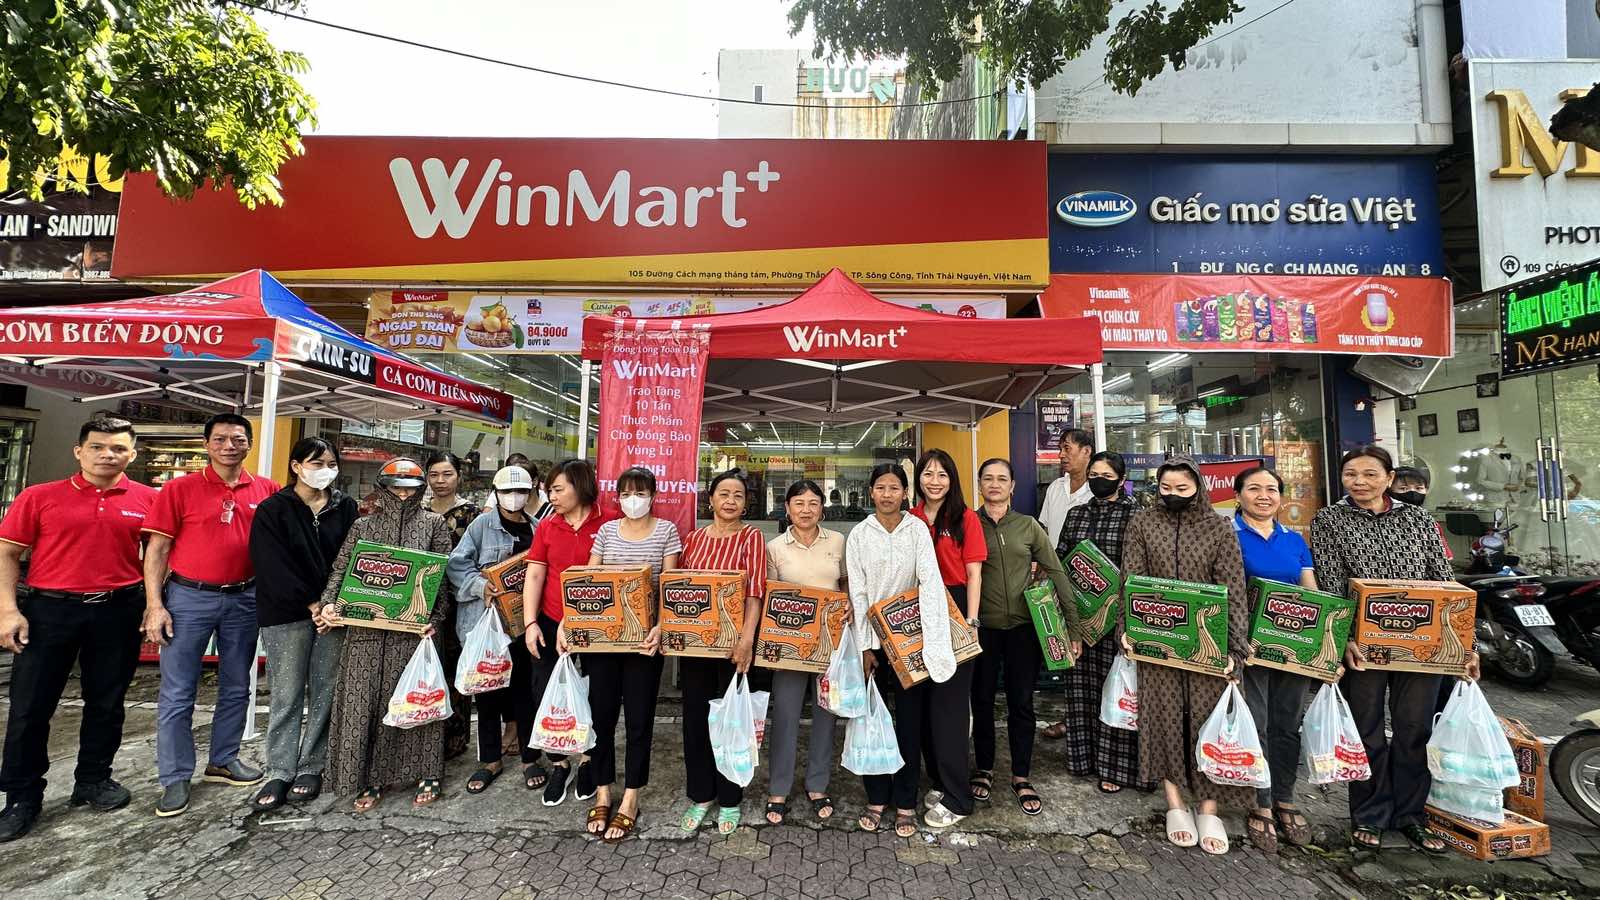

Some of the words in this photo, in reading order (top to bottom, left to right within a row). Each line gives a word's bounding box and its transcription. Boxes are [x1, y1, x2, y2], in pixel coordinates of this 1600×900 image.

[1064, 200, 1130, 212] VINAMILK
[1150, 193, 1221, 222] Giấc
[1231, 198, 1280, 222] mơ
[1287, 194, 1347, 223] sữa
[1351, 197, 1417, 230] Việt
[628, 270, 643, 278] 105
[646, 269, 673, 279] Đường
[676, 270, 696, 278] Cách
[699, 271, 722, 280] mạng
[724, 270, 748, 279] tháng
[771, 270, 802, 280] Phường
[865, 271, 887, 280] Sông
[889, 271, 914, 280] Công,
[916, 271, 934, 280] Tỉnh
[937, 272, 954, 280] Thái
[957, 272, 991, 281] Nguyên,
[993, 272, 1010, 282] Việt
[1523, 264, 1541, 273] 109
[1089, 287, 1130, 303] Vinamilk
[1103, 309, 1123, 324] CHÍN
[138, 321, 224, 345] ĐÔNG
[527, 326, 568, 338] 84.900đ
[1134, 328, 1154, 343] THAY
[296, 333, 372, 376] CHIN-SU
[613, 359, 697, 380] WinMart
[382, 364, 404, 387] CÁ
[405, 372, 436, 393] CƠM
[628, 386, 651, 396] Trao
[636, 400, 649, 410] 10
[610, 429, 633, 440] Cho
[656, 479, 697, 493] GUYÊN
[357, 558, 408, 578] KOKOMI
[1071, 555, 1107, 592] KOKOMI
[366, 574, 391, 587] PRO
[1072, 572, 1089, 590] PRO
[567, 586, 611, 600] KOKOMI
[665, 589, 709, 604] KOKOMI
[580, 602, 600, 612] PRO
[677, 605, 697, 615] PRO
[771, 597, 815, 615] KOKOMI
[1132, 599, 1185, 617] KOKOMI
[1268, 599, 1317, 620] KOKOMI
[1369, 600, 1428, 618] KOKOMI
[779, 614, 799, 626] PRO
[1146, 616, 1171, 627] PRO
[1276, 616, 1301, 629] PRO
[1385, 618, 1411, 628] PRO
[551, 735, 577, 747] 20%
